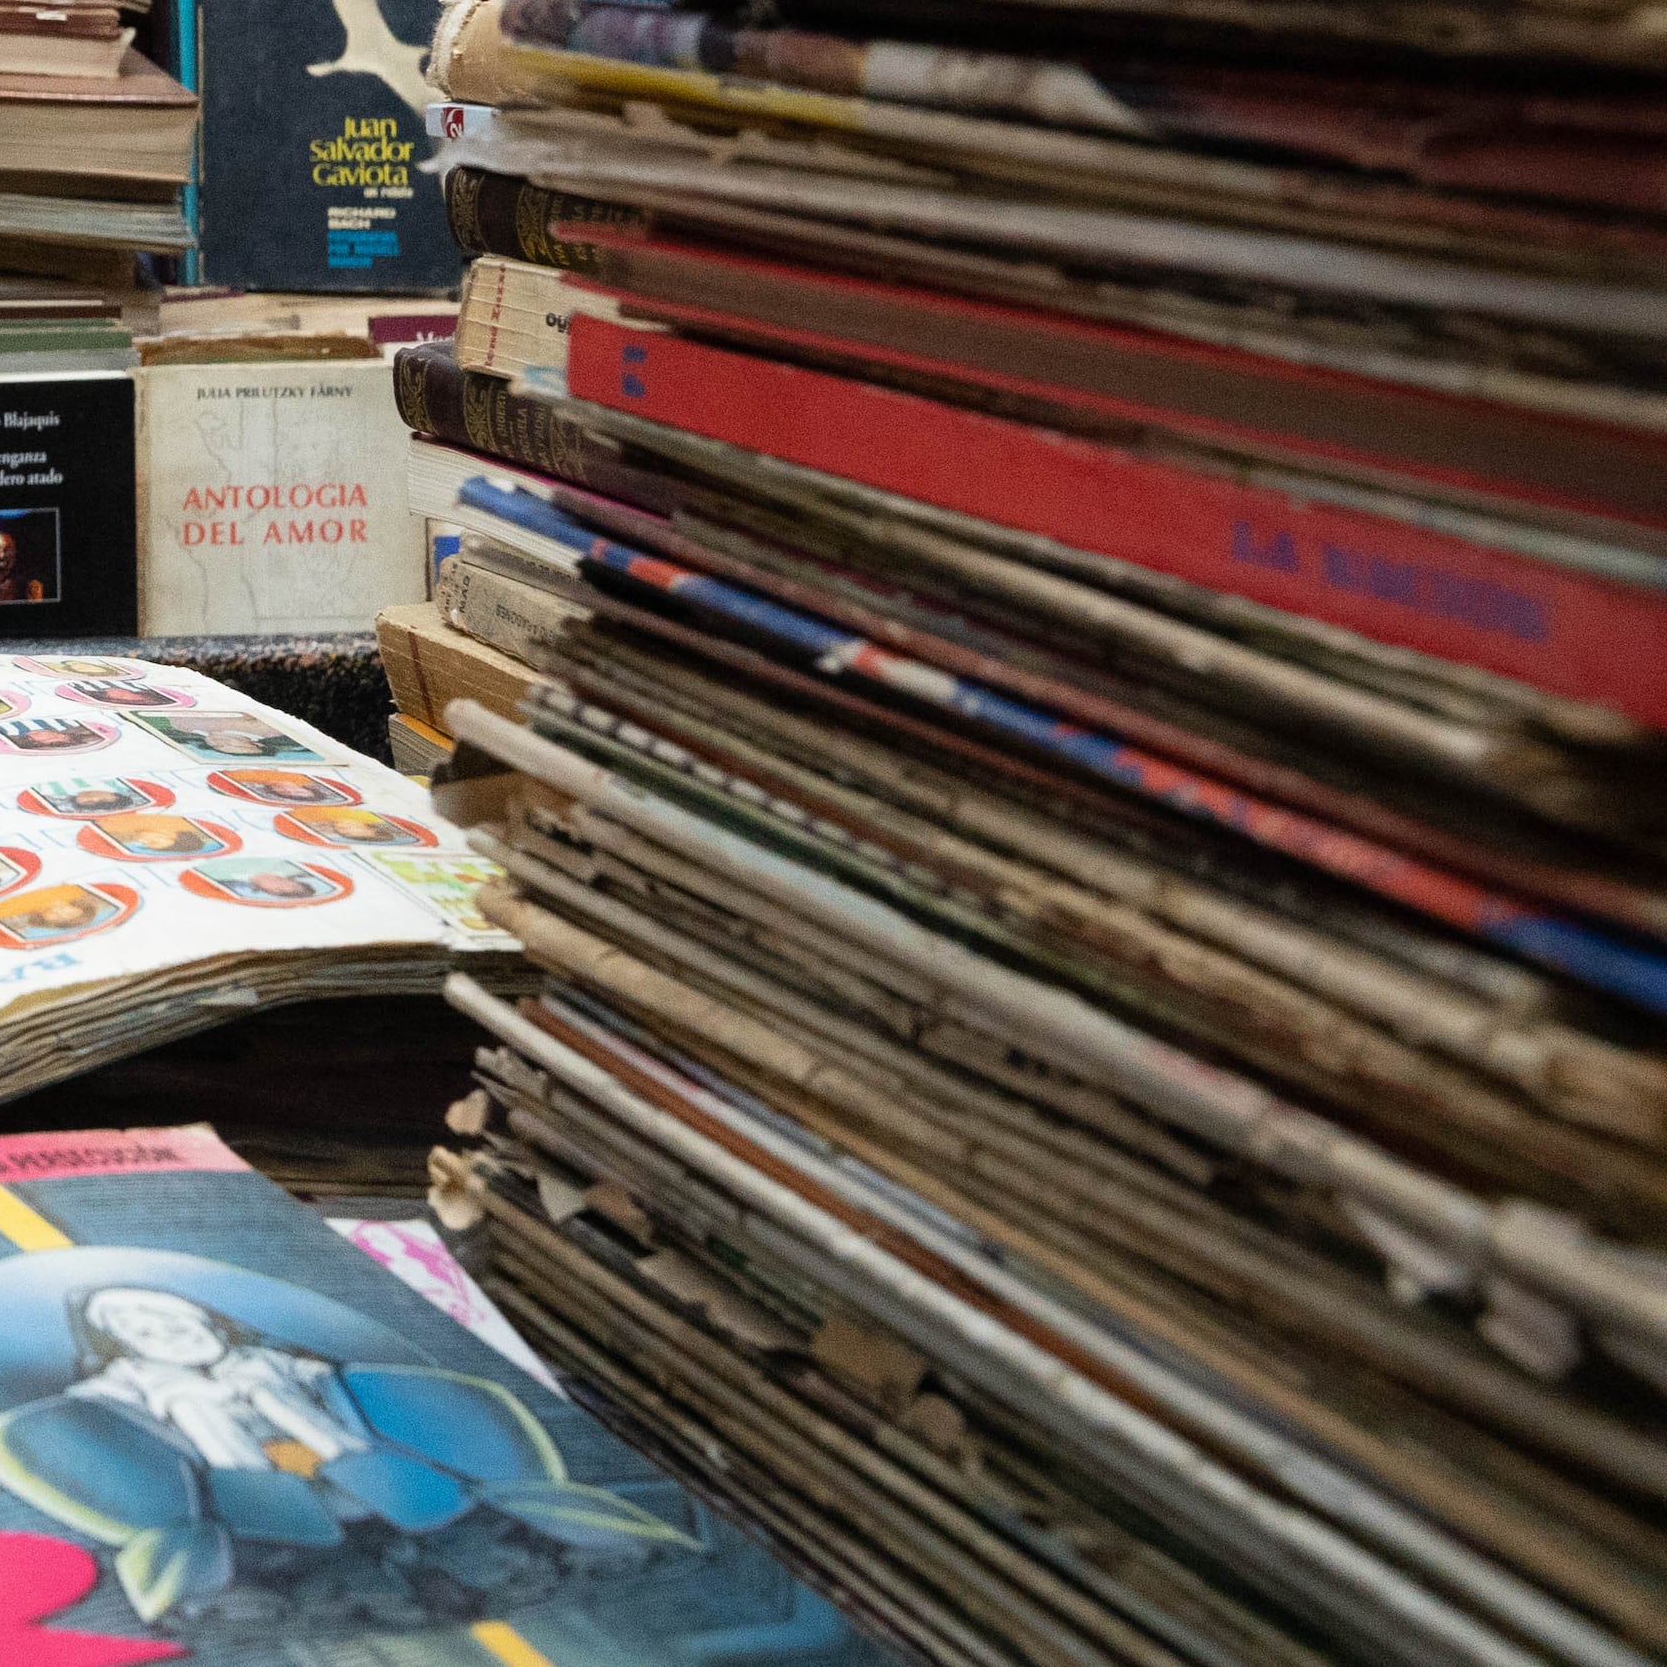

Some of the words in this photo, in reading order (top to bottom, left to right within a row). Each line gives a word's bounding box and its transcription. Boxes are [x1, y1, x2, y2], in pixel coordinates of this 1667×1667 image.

[344, 115, 397, 139] Juan
[310, 136, 414, 162] Salvador
[312, 162, 409, 186] Gaviota
[197, 386, 232, 400] JULIA
[3, 410, 61, 432] Blajaquis
[27, 467, 64, 486] atado
[182, 482, 368, 511] ANTOLOGIA
[183, 520, 244, 546] DEL
[263, 518, 368, 546] AMOR
